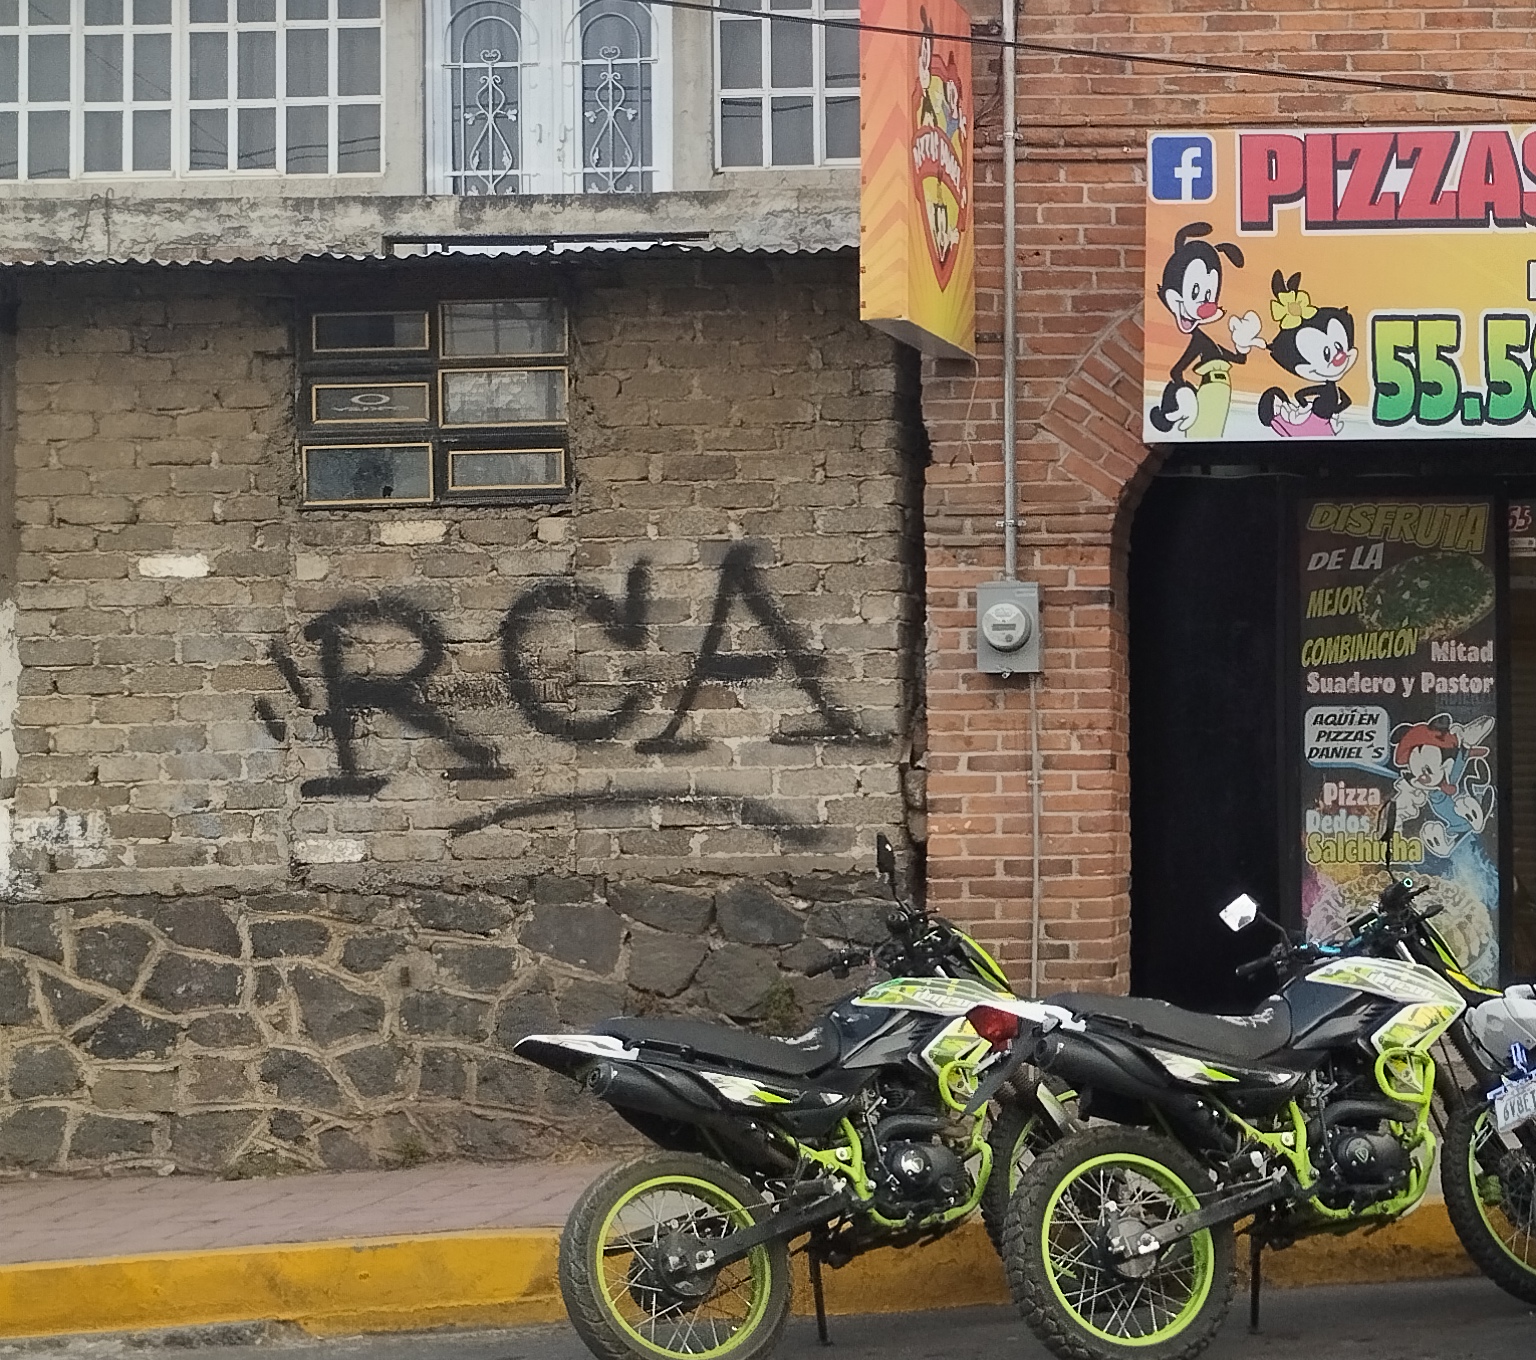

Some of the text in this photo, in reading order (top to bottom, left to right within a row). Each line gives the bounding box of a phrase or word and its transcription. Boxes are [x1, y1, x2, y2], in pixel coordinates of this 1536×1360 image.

[1307, 503, 1489, 554] DISFRUTA
[1307, 543, 1384, 571] DE LA
[1306, 585, 1365, 619] MEJOR
[1301, 616, 1418, 668] COMBINACIÓN
[1431, 640, 1494, 662] Mitad
[1306, 671, 1495, 697] Suadero y Pastor
[1313, 709, 1380, 726] AQUÍ EN
[1315, 730, 1376, 742] PIZZAS
[1323, 781, 1380, 806] Pizza
[1306, 808, 1370, 833] Dedos
